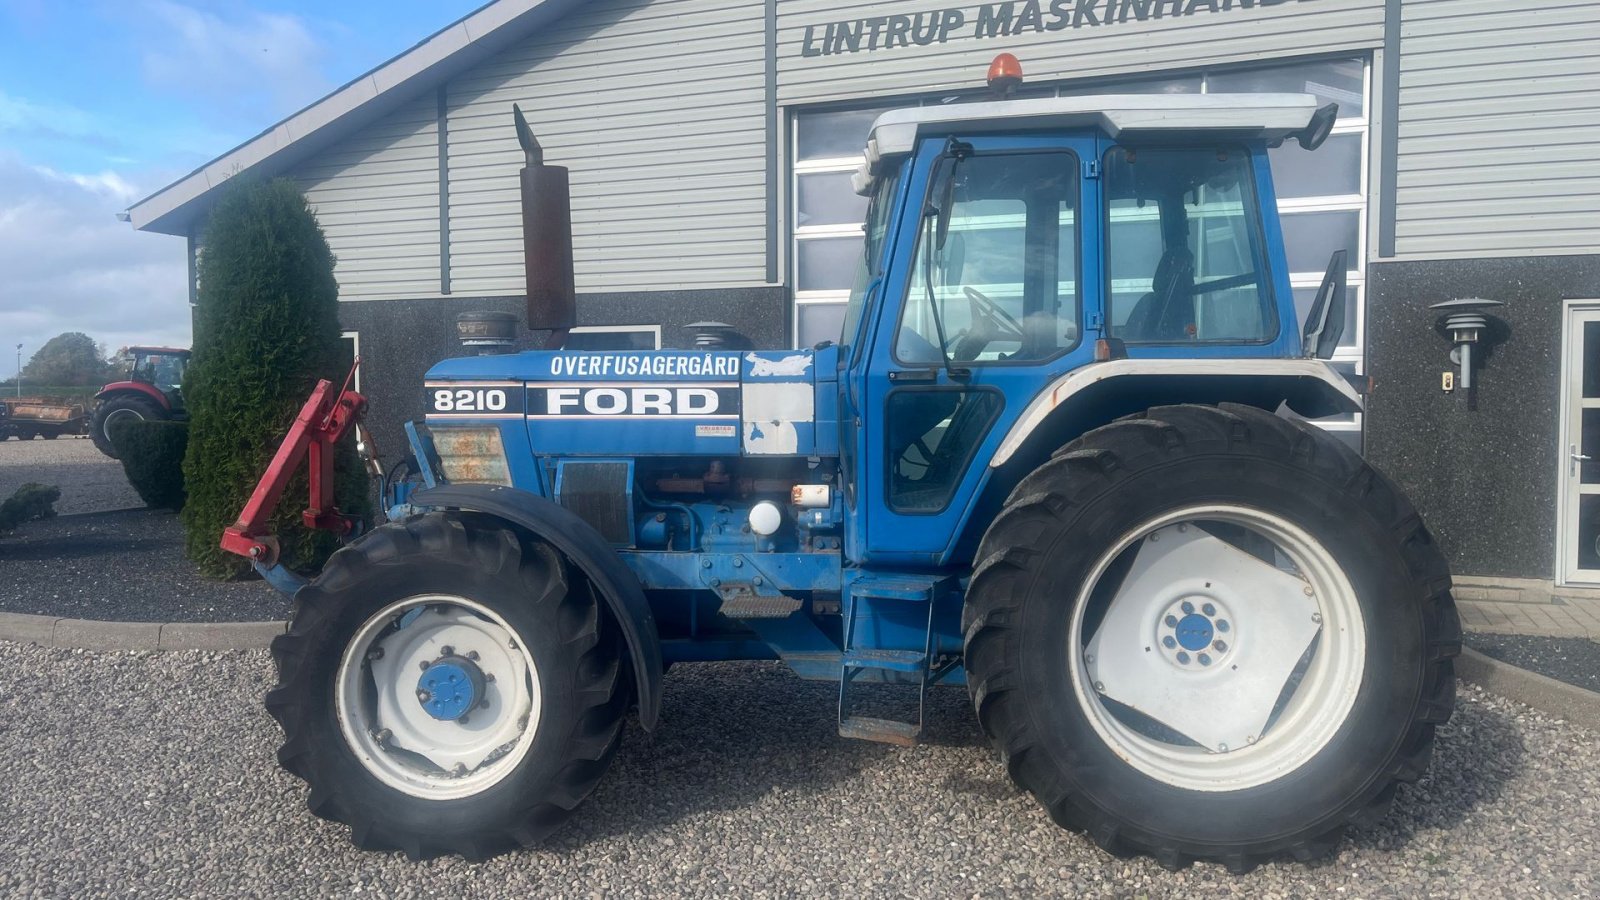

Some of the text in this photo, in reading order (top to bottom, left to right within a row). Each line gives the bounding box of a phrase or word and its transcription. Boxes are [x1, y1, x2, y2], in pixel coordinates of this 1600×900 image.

[802, 9, 964, 57] LINTRUP
[550, 353, 740, 376] OVERFUSAGERGÅRD
[434, 389, 506, 411] 8210
[547, 388, 719, 415] FORD
